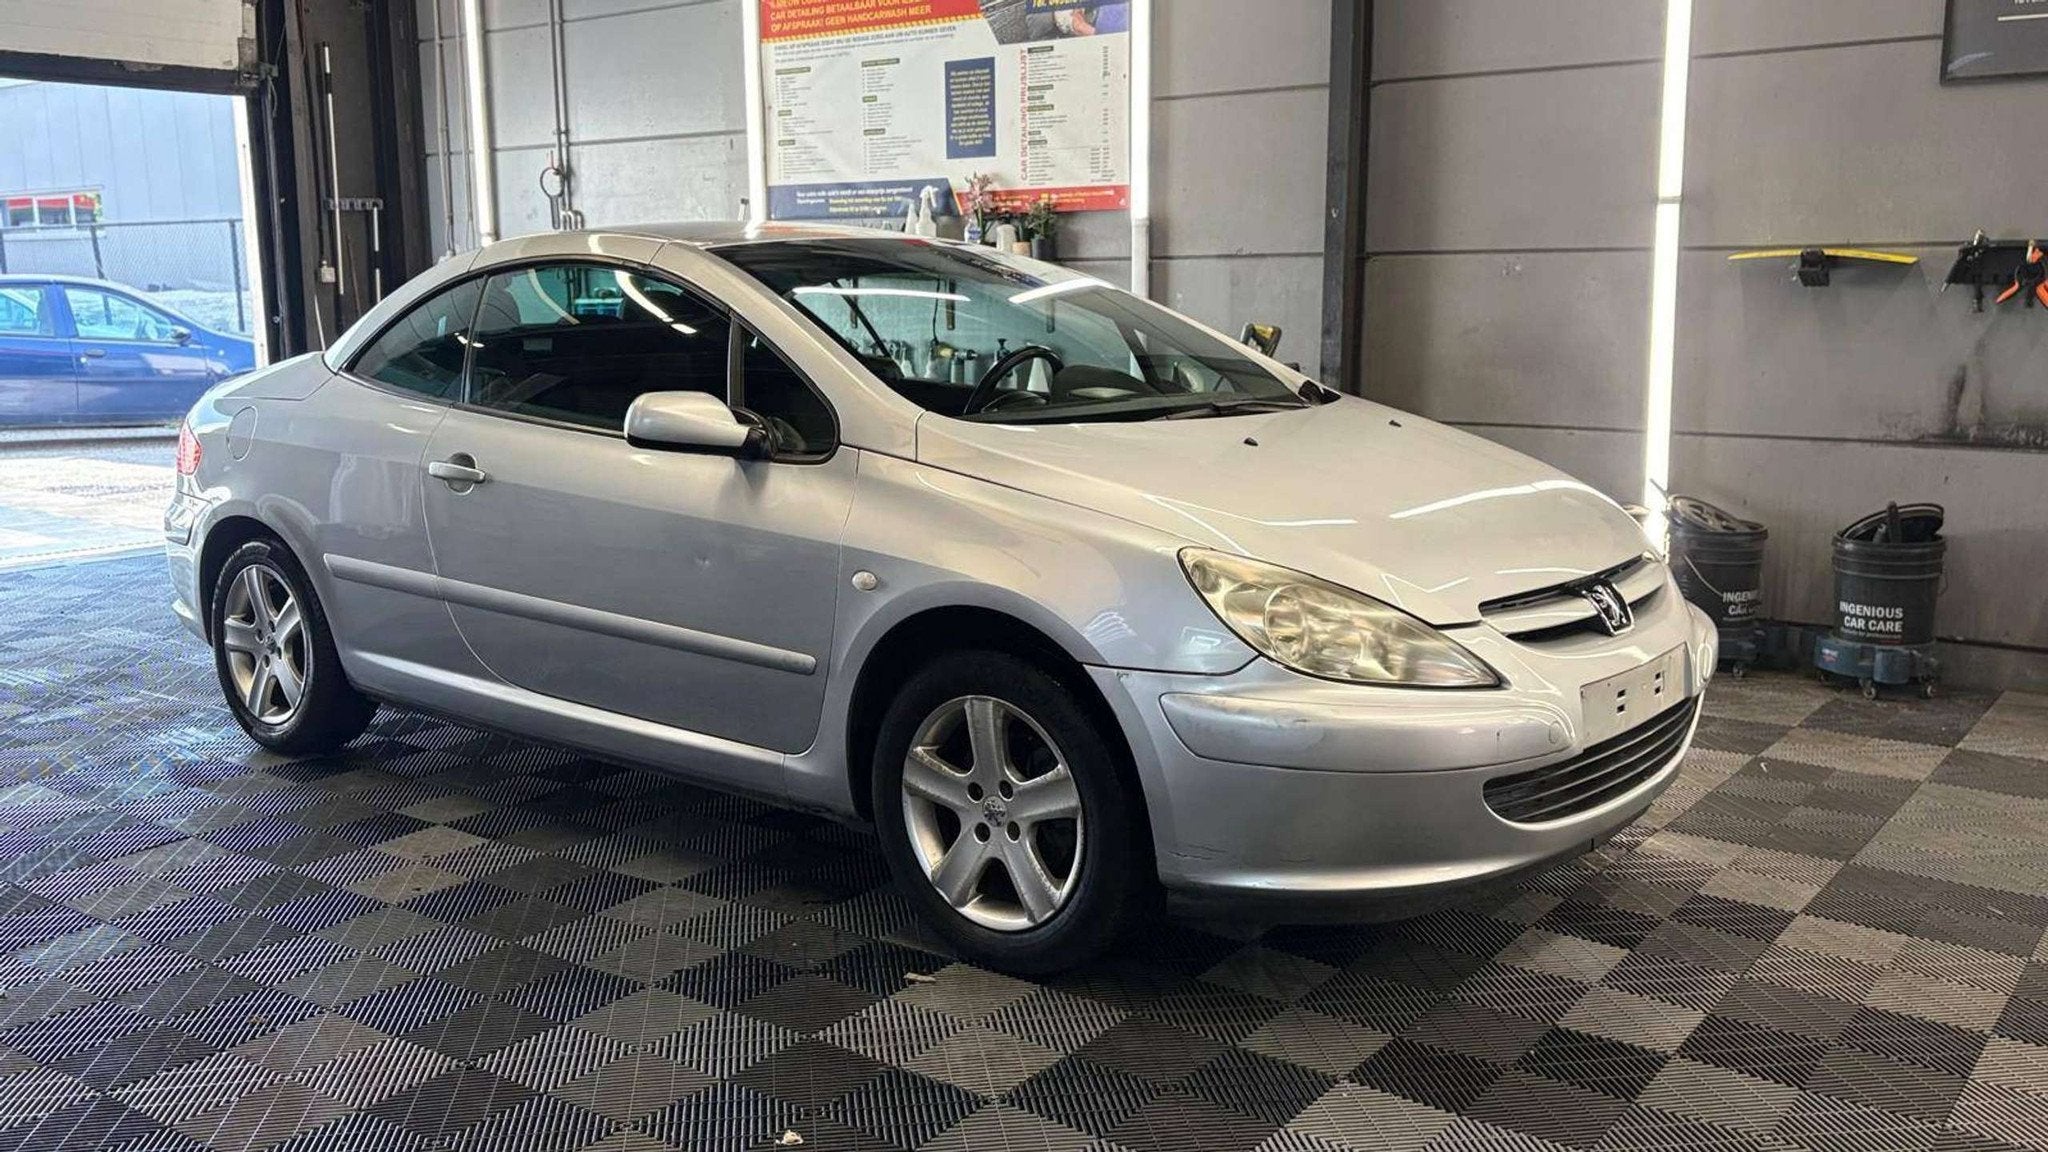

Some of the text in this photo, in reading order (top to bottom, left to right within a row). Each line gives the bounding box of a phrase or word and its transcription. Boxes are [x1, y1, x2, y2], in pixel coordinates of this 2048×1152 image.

[771, 10, 786, 20] CAR
[786, 6, 825, 18] DETAILING
[771, 23, 781, 32] OP
[825, 16, 846, 26] GEEN
[909, 5, 932, 15] MEER
[1839, 600, 1903, 619] INGENIOUS
[1844, 615, 1903, 632] CAR CARE
